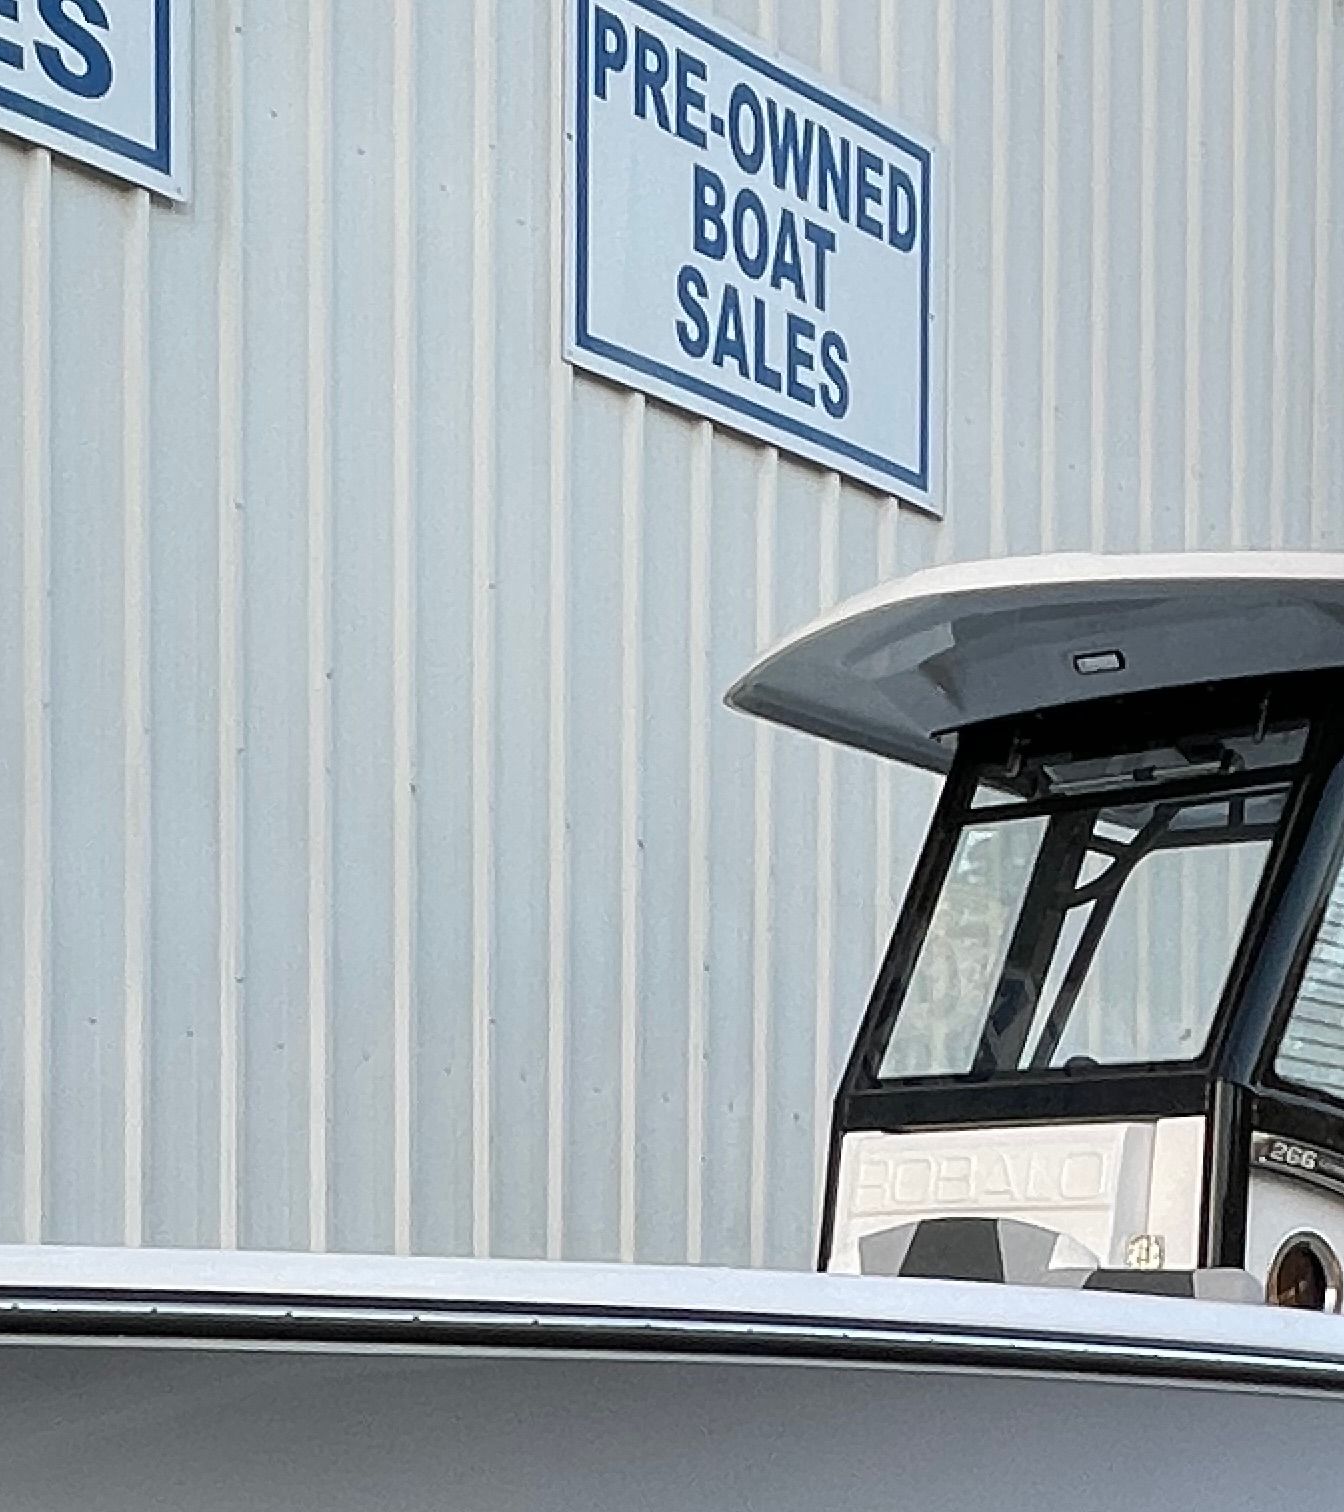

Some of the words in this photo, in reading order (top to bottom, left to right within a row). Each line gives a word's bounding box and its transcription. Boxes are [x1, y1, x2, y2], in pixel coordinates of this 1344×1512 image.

[594, 4, 918, 253] PRE-OWNED
[692, 162, 838, 312] BOAT
[674, 264, 851, 420] SALES
